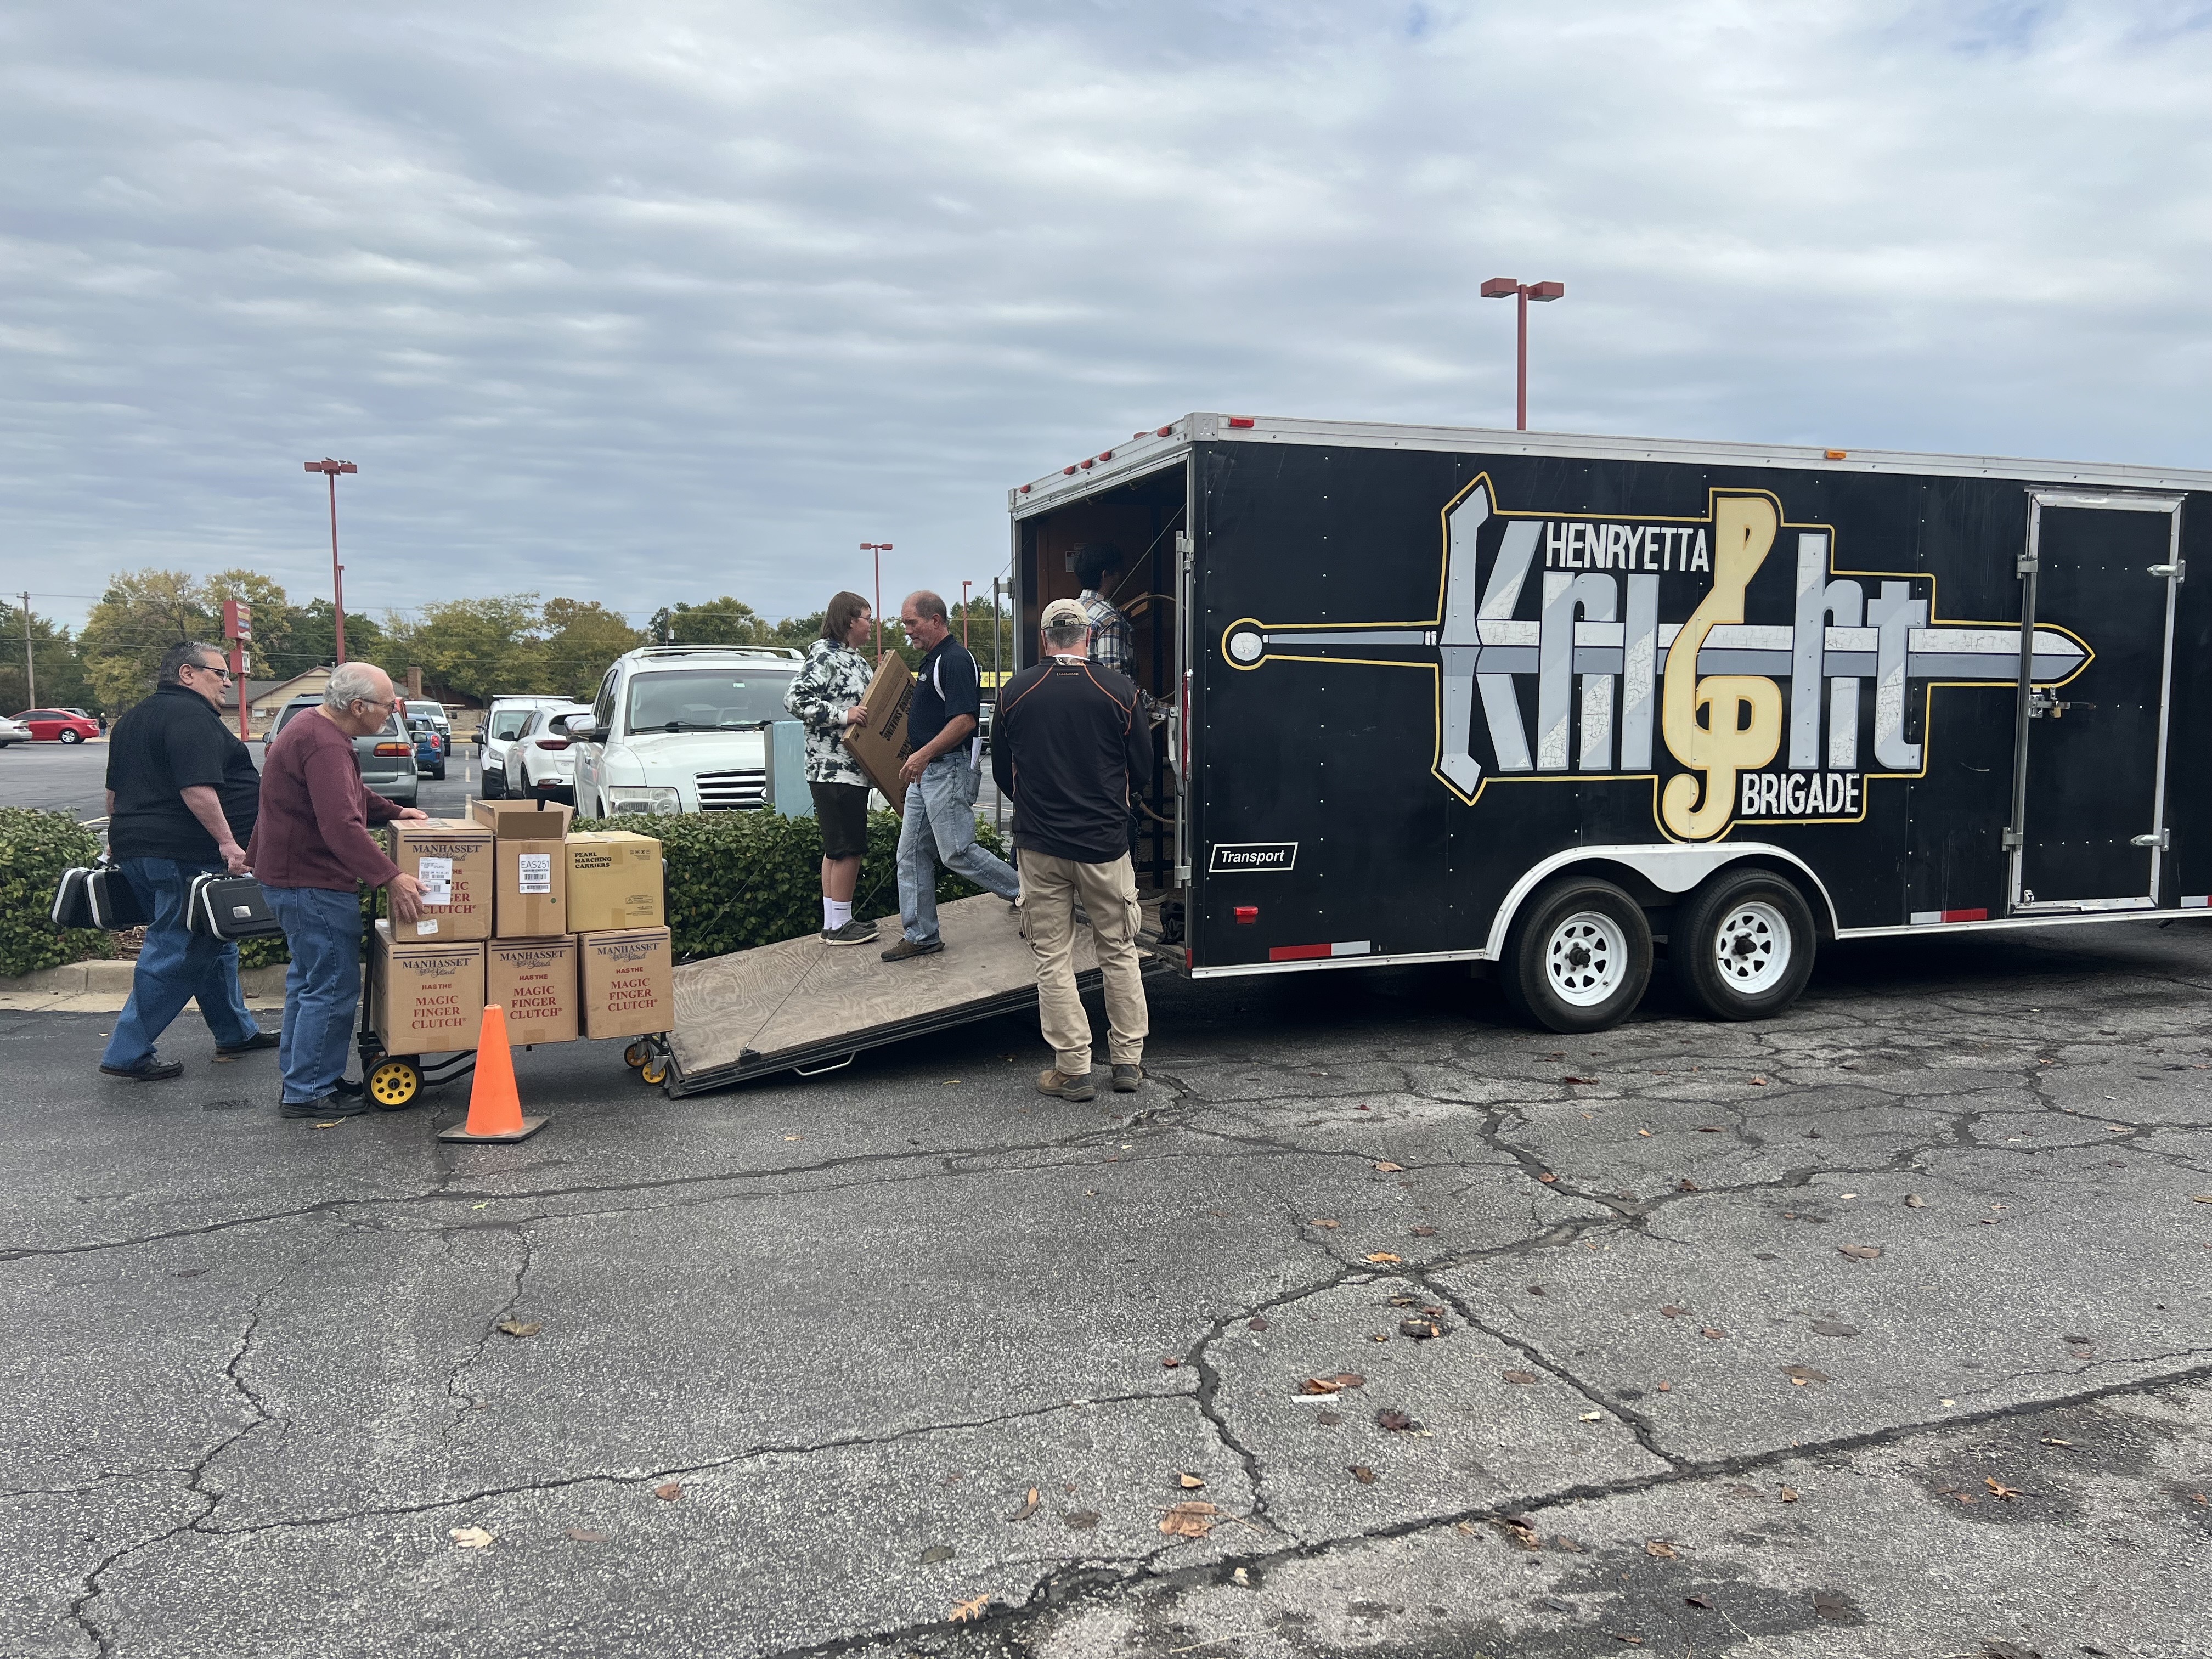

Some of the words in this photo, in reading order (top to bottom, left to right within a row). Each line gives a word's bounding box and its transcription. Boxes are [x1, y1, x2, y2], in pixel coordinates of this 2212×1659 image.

[1545, 522, 1709, 572] HENRYETTA
[1741, 772, 1860, 815] BRIGADE
[1221, 850, 1285, 865] Transport
[611, 978, 650, 989] MAGIC
[513, 985, 555, 996] MAGIC
[609, 989, 652, 1001] FINGER
[416, 995, 459, 1006] MAGIC
[511, 997, 556, 1008] FINGER
[414, 1007, 460, 1018] FINGER
